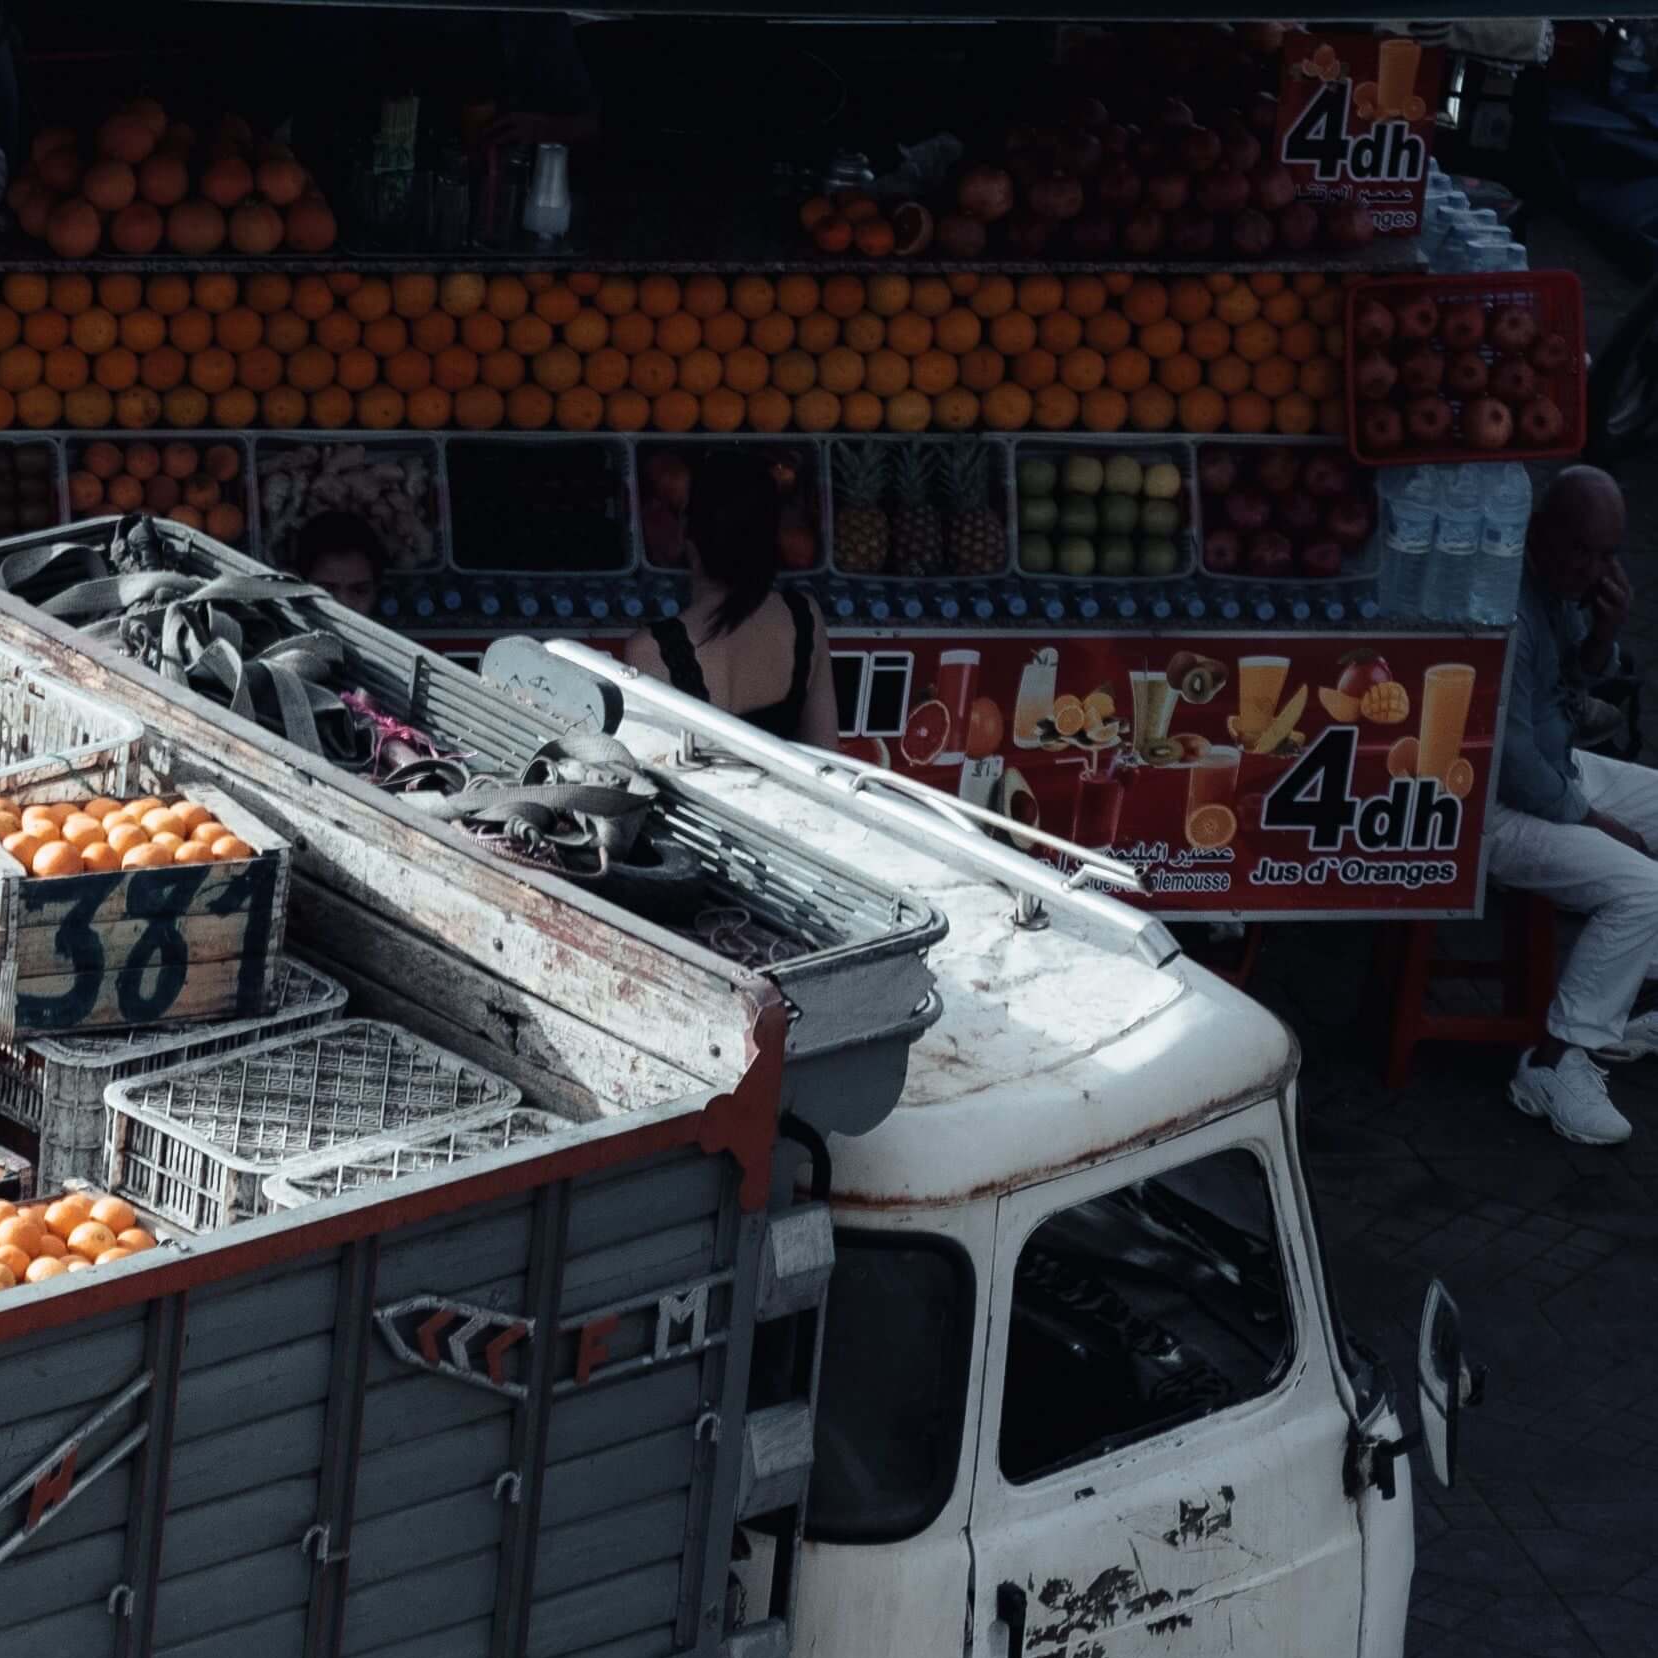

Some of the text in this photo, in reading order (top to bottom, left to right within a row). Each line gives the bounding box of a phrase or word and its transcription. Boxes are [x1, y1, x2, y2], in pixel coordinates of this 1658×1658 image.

[1282, 77, 1425, 182] 4dh
[1260, 725, 1465, 854] 4dh
[1251, 858, 1302, 885] Jus
[15, 860, 281, 1029] 381
